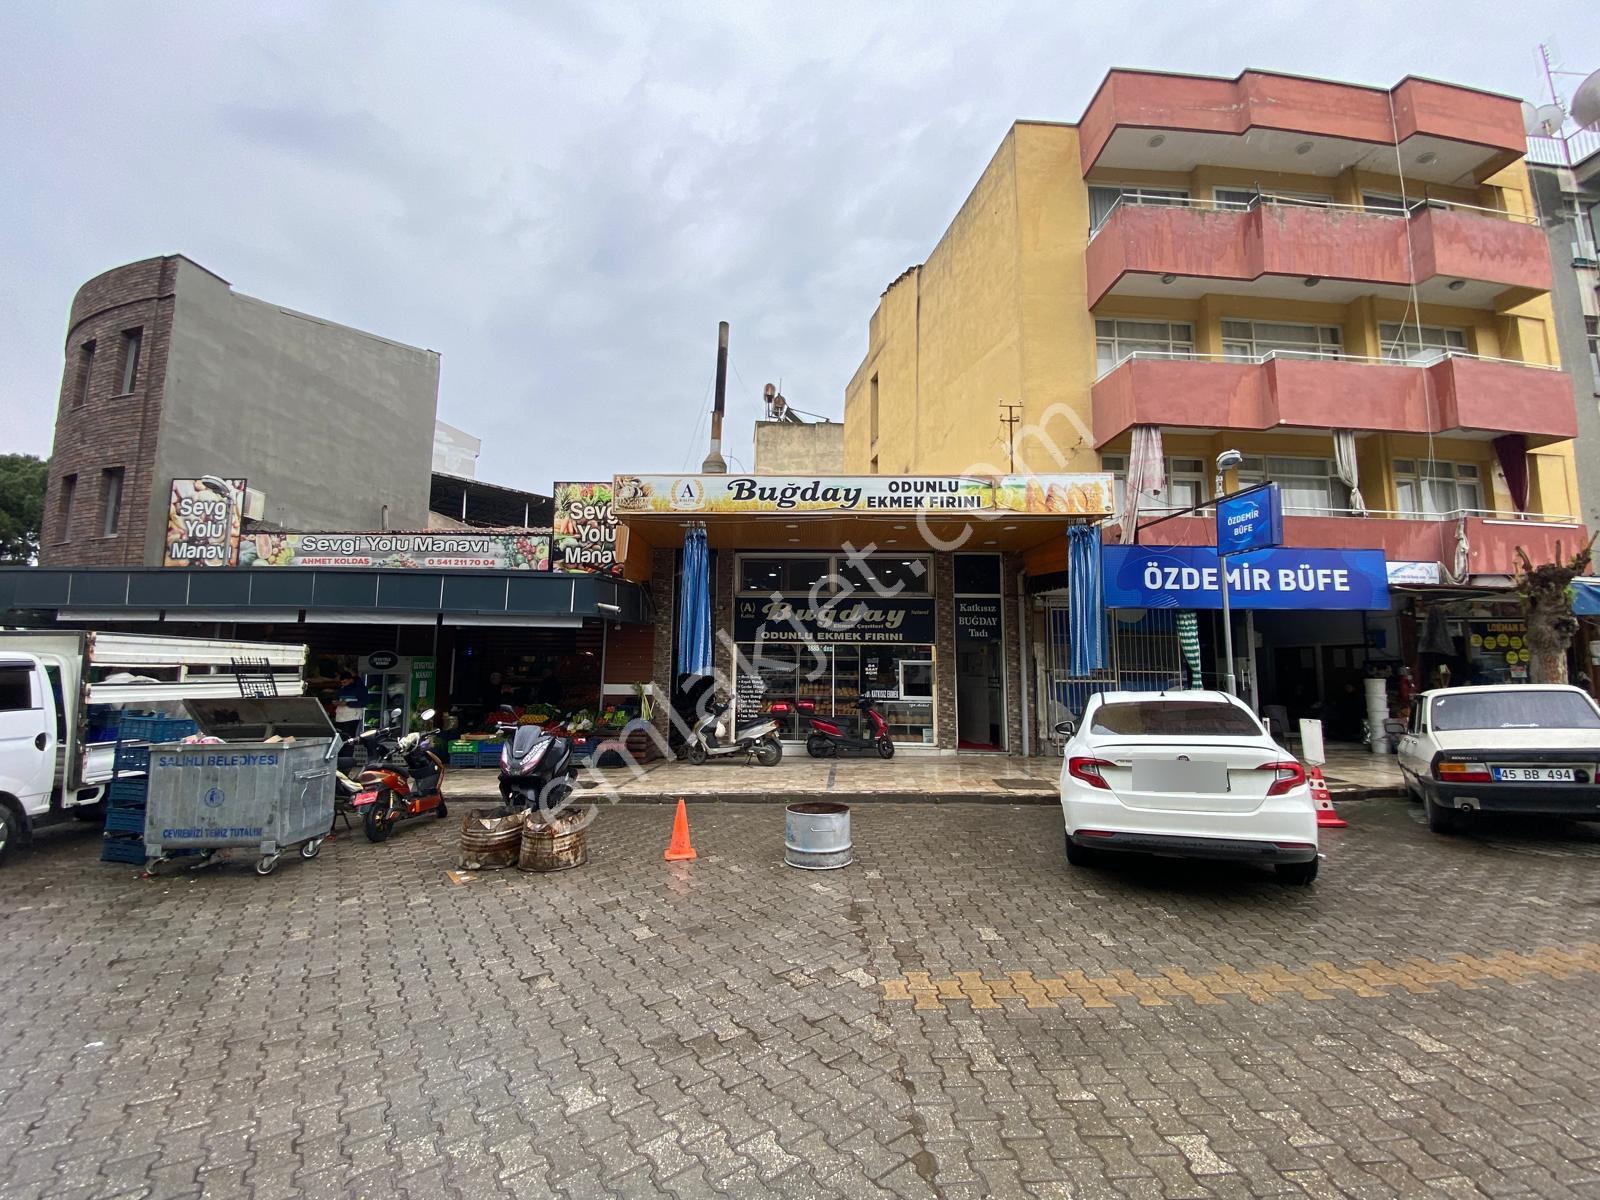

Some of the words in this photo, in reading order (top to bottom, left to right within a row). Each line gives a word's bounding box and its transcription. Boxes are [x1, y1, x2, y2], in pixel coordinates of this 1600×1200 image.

[681, 483, 695, 498] A
[727, 478, 863, 509] Buğday
[888, 480, 960, 493] ODUNLU
[180, 498, 227, 520] Sevg
[866, 496, 925, 508] EKMEK
[929, 496, 982, 508] FIRINI
[570, 502, 619, 525] Sevg
[1227, 509, 1259, 526] ÖZDEMİR
[186, 520, 223, 538] Yolu
[578, 525, 617, 543] Yolu
[1233, 523, 1254, 536] BÜFE
[302, 536, 362, 555] Sevgi
[366, 537, 410, 552] Yolu
[413, 537, 490, 553] Manavı
[565, 548, 617, 564] Mana
[1144, 561, 1271, 591] ÖZDEMİR
[1279, 564, 1350, 592] BÜFE
[761, 601, 907, 629] Buğday
[959, 615, 998, 626] BUĞDAY
[761, 631, 813, 640] ODUNLU
[817, 632, 862, 640] EKMEK
[864, 633, 904, 641] FIRINI
[969, 628, 989, 637] Tadı
[207, 753, 279, 767] BELEDİYESİ
[1501, 769, 1517, 779] 45
[1524, 769, 1540, 780] BB
[1547, 769, 1571, 780] 494
[205, 827, 228, 838] TEMİZ
